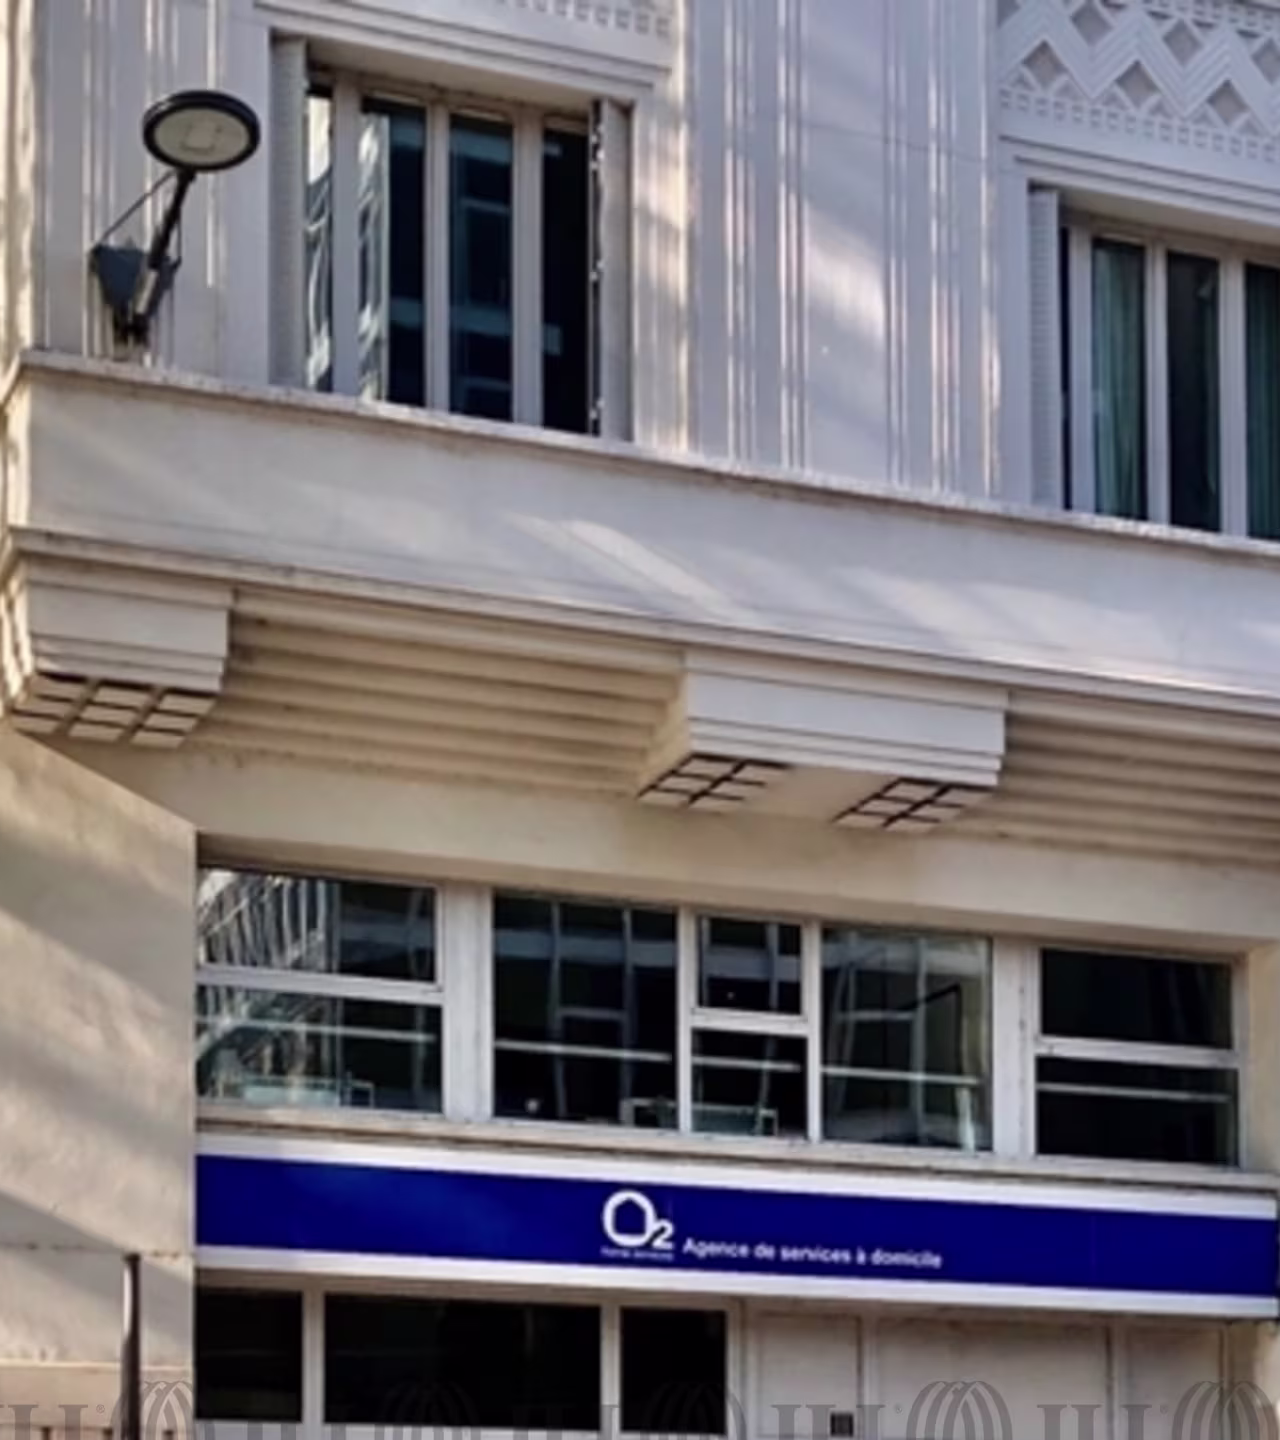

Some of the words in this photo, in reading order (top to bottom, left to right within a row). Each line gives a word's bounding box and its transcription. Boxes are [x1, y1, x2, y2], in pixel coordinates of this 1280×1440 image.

[682, 1237, 749, 1259] Agence
[754, 1244, 775, 1260] de
[780, 1246, 852, 1265] services
[871, 1249, 943, 1269] domicile
